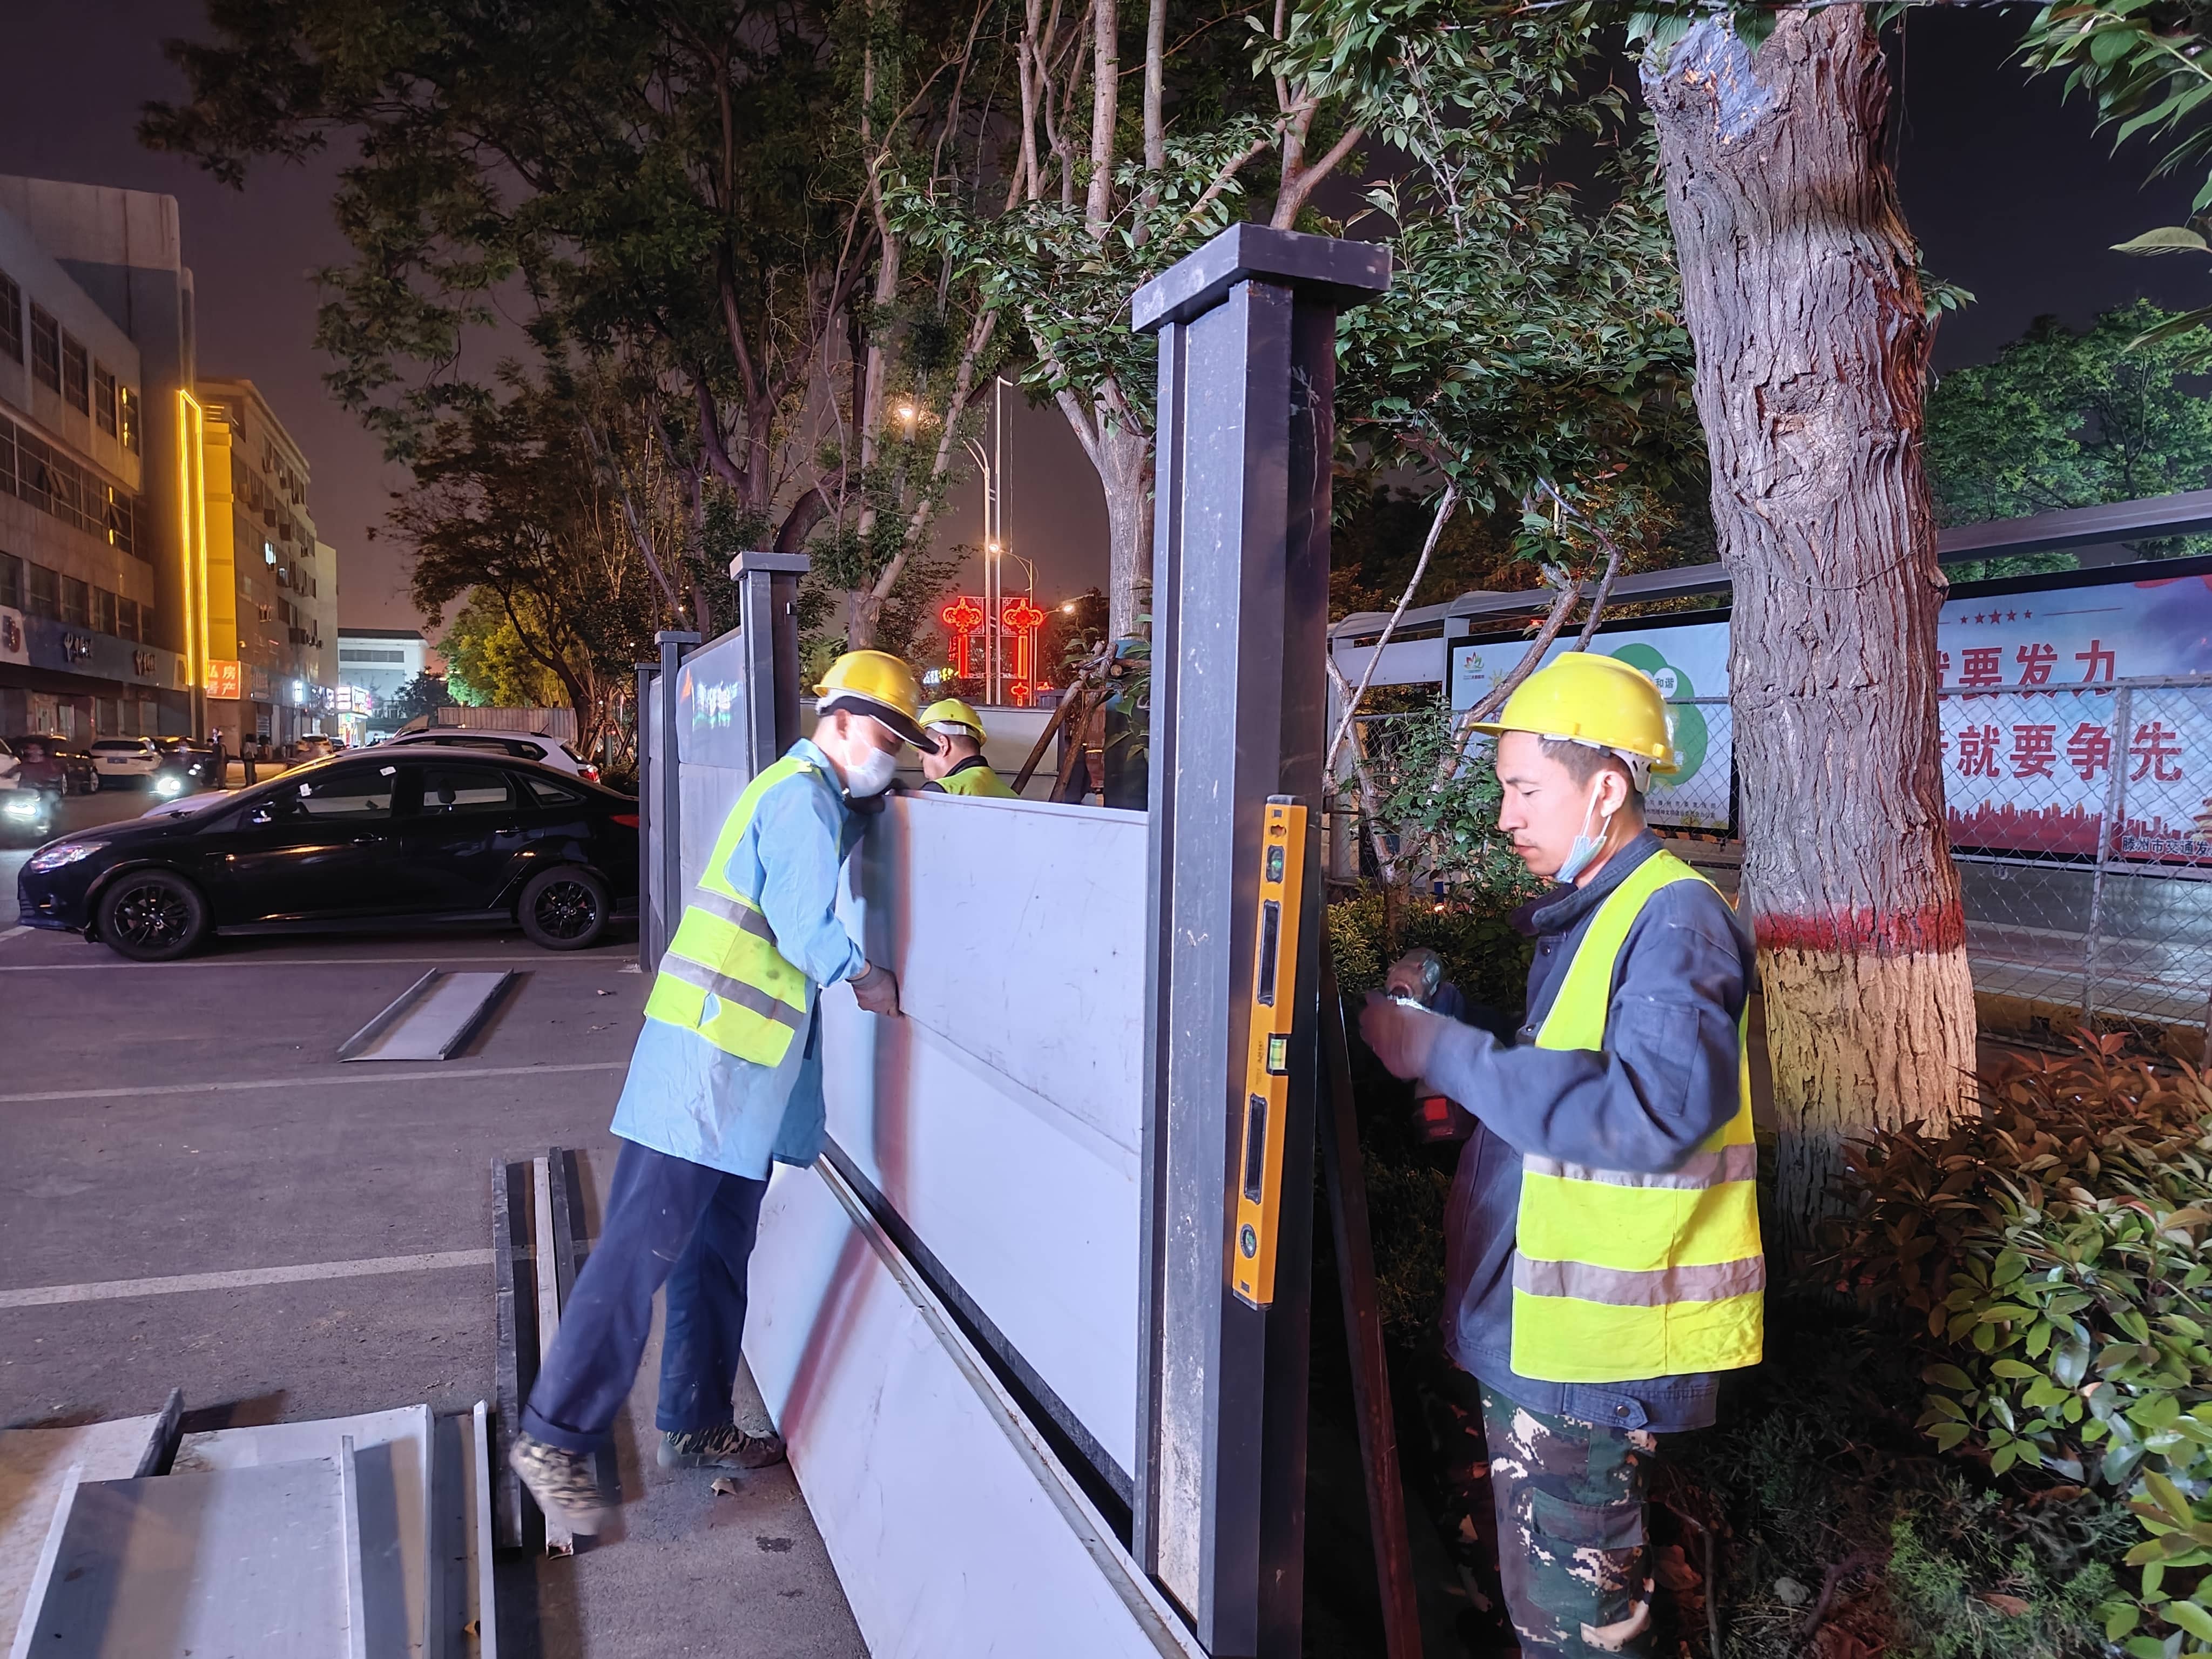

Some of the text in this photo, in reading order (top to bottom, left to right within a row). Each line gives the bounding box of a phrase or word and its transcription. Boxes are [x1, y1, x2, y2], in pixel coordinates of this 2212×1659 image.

[1655, 678, 1675, 689] 和谐
[1940, 721, 2182, 781] 就要争先
